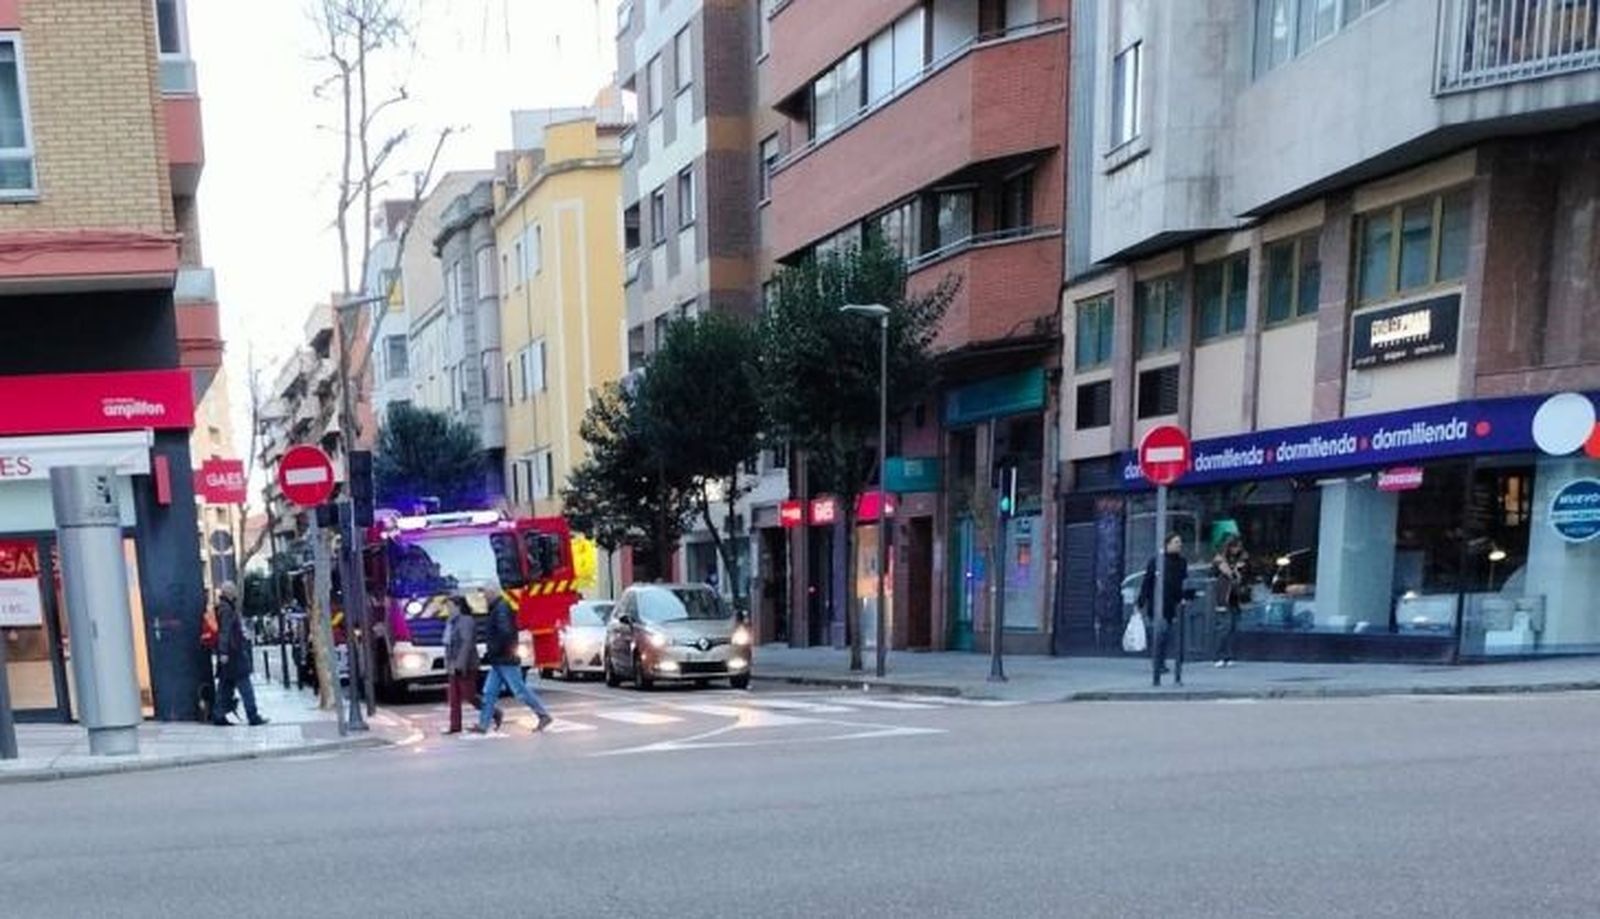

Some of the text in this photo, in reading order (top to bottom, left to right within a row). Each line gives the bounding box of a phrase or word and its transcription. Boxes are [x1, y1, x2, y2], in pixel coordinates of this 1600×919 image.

[1194, 417, 1468, 471] dormitienda dormitienda dormitienda
